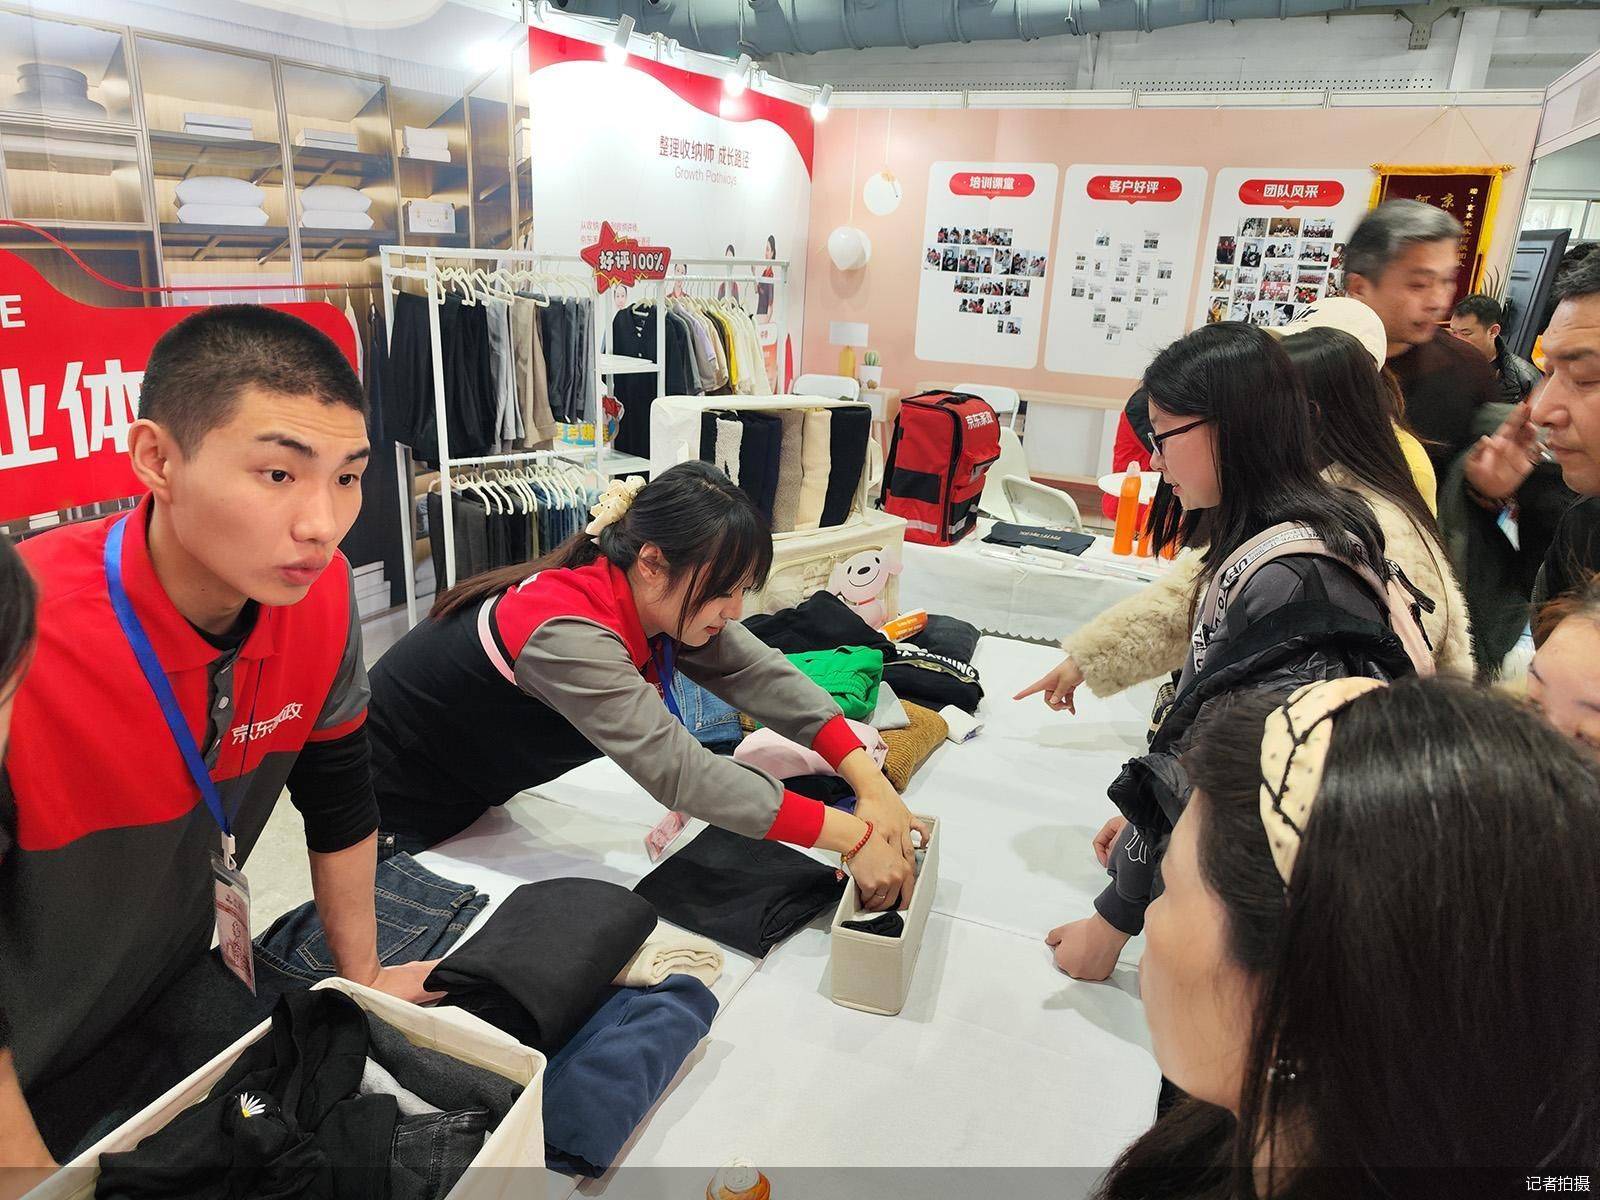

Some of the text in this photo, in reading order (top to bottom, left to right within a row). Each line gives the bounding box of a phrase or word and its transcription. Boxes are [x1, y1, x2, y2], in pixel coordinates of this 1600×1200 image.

[660, 135, 750, 169] 整理收纳师 成长路径
[674, 165, 704, 181] Growth
[969, 176, 1015, 191] 培训课堂
[1109, 180, 1160, 194] 客户好评
[1263, 183, 1319, 199] 团队风采
[599, 250, 664, 272] 好评100%
[231, 702, 304, 746] 京东政
